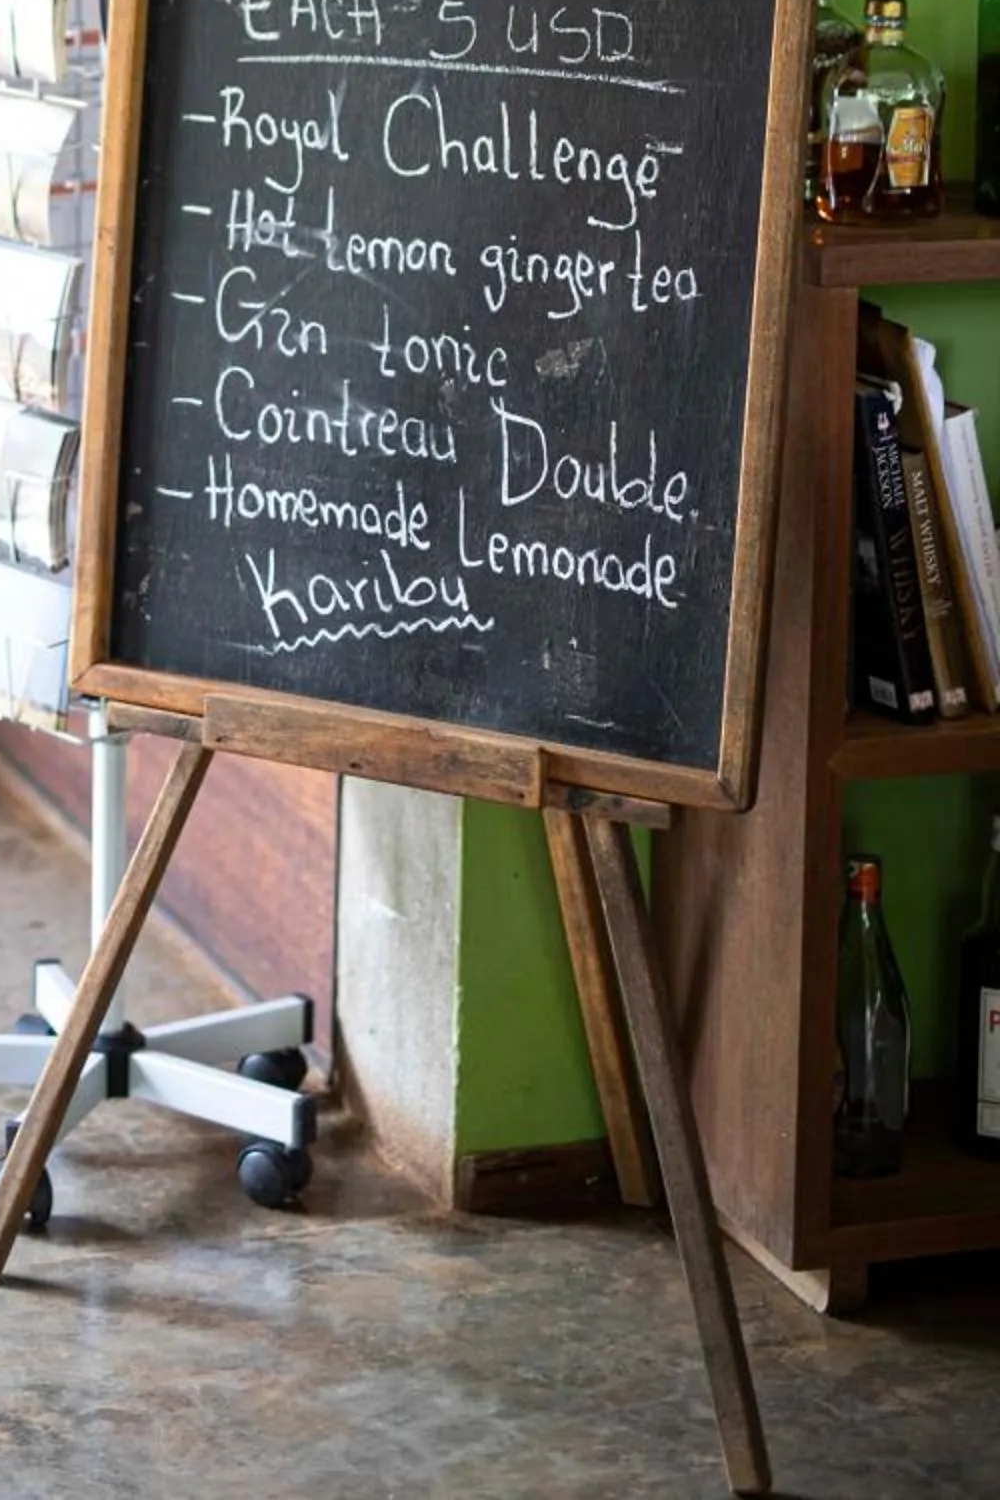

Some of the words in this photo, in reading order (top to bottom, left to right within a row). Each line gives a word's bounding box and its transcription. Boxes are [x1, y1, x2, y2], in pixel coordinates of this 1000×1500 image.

[506, 4, 636, 65] USD
[219, 84, 350, 194] Royal
[383, 83, 661, 231] Challenge
[226, 187, 311, 258] Hot
[479, 234, 616, 319] ginger
[627, 229, 701, 313] tea
[215, 264, 328, 358] Gin
[368, 302, 508, 387] tonic
[213, 365, 458, 465] Cointreau
[204, 451, 431, 551] Homemade
[459, 485, 681, 609] Lemonade
[911, 468, 930, 516] MALT
[919, 517, 943, 586] WHISKY
